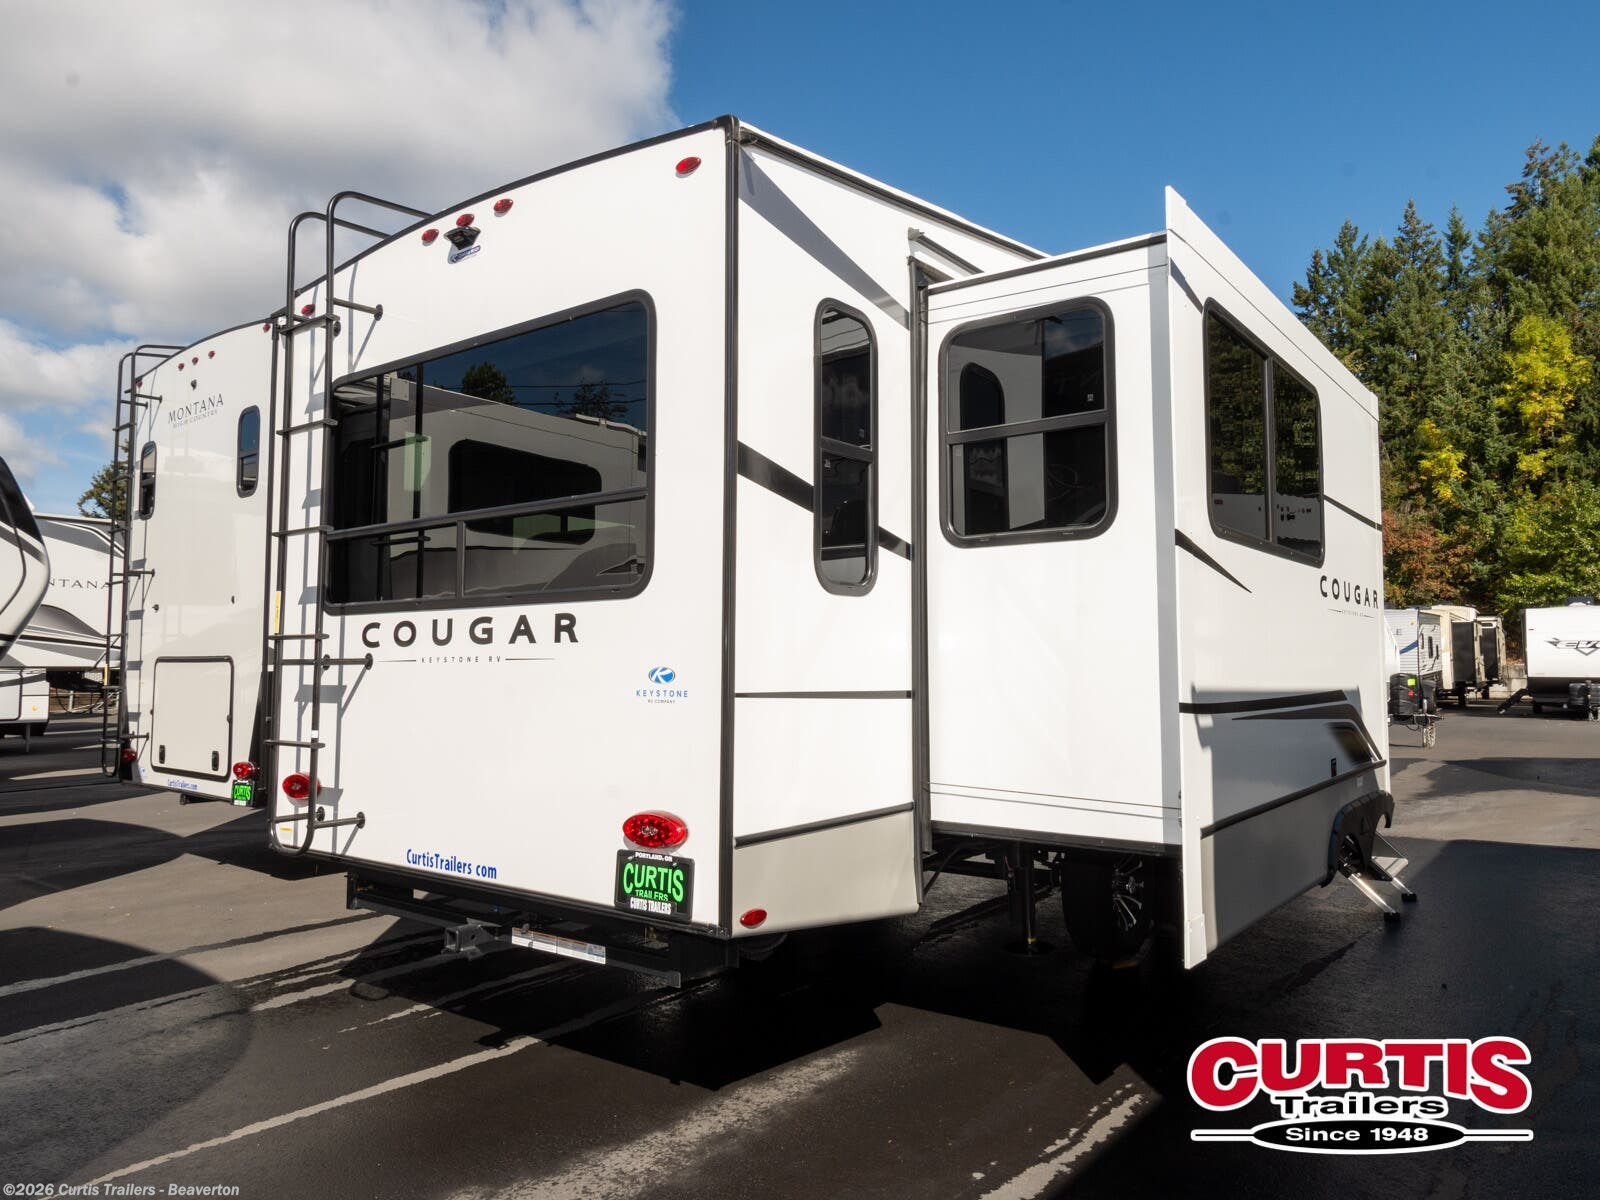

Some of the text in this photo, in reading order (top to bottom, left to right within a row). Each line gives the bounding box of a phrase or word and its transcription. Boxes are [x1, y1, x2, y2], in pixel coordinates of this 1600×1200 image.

[168, 393, 223, 424] MONTANA
[1320, 575, 1379, 609] COUGAR
[361, 612, 579, 648] COUGAR
[421, 655, 502, 664] KEYSTONE RV
[636, 689, 688, 698] KEYSTONE
[635, 851, 664, 862] PORTLAND,
[623, 862, 684, 902] CURTIS
[635, 889, 669, 902] TRAILERS
[630, 896, 672, 915] CURTIS TRAILERS
